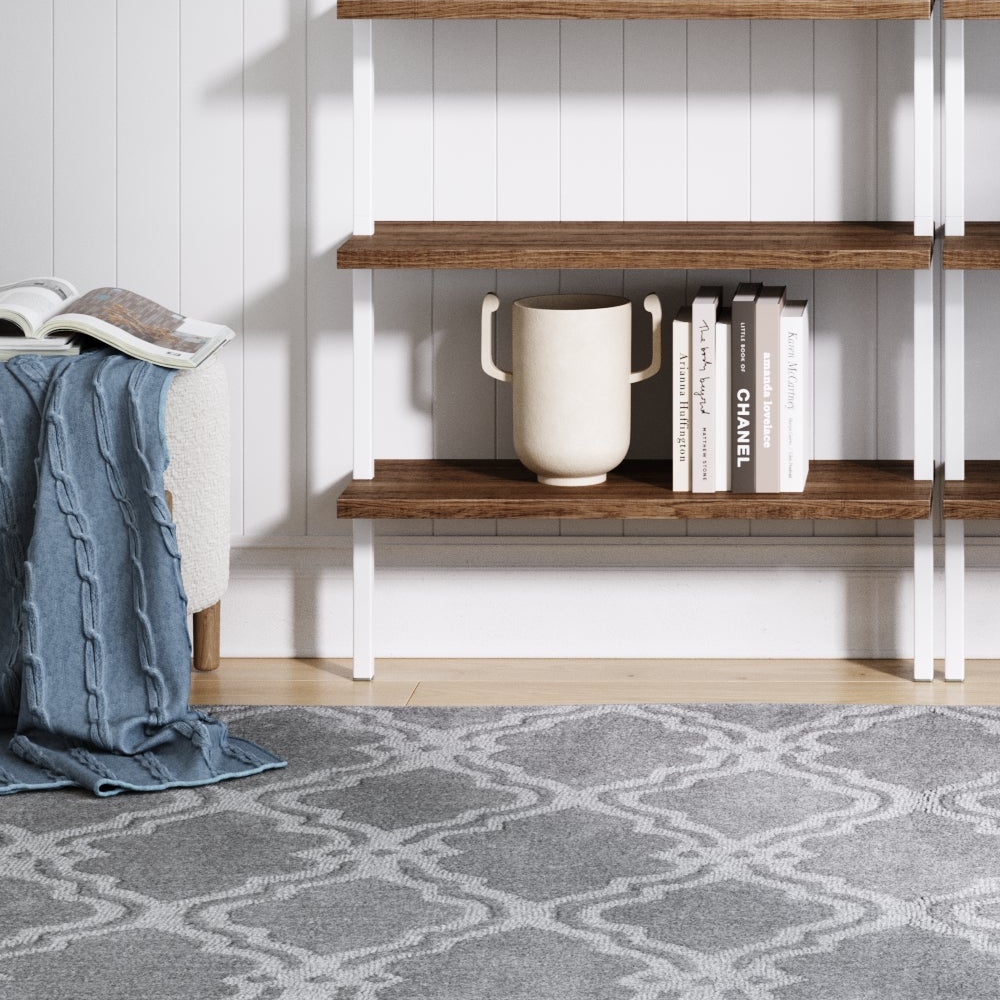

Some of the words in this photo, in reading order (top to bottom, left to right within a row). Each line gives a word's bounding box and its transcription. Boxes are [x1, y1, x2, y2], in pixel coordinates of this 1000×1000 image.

[679, 353, 688, 396] Arianna
[740, 364, 746, 373] OF
[763, 352, 772, 398] amanda
[678, 401, 689, 462] Huffington
[737, 388, 750, 468] CHANEL
